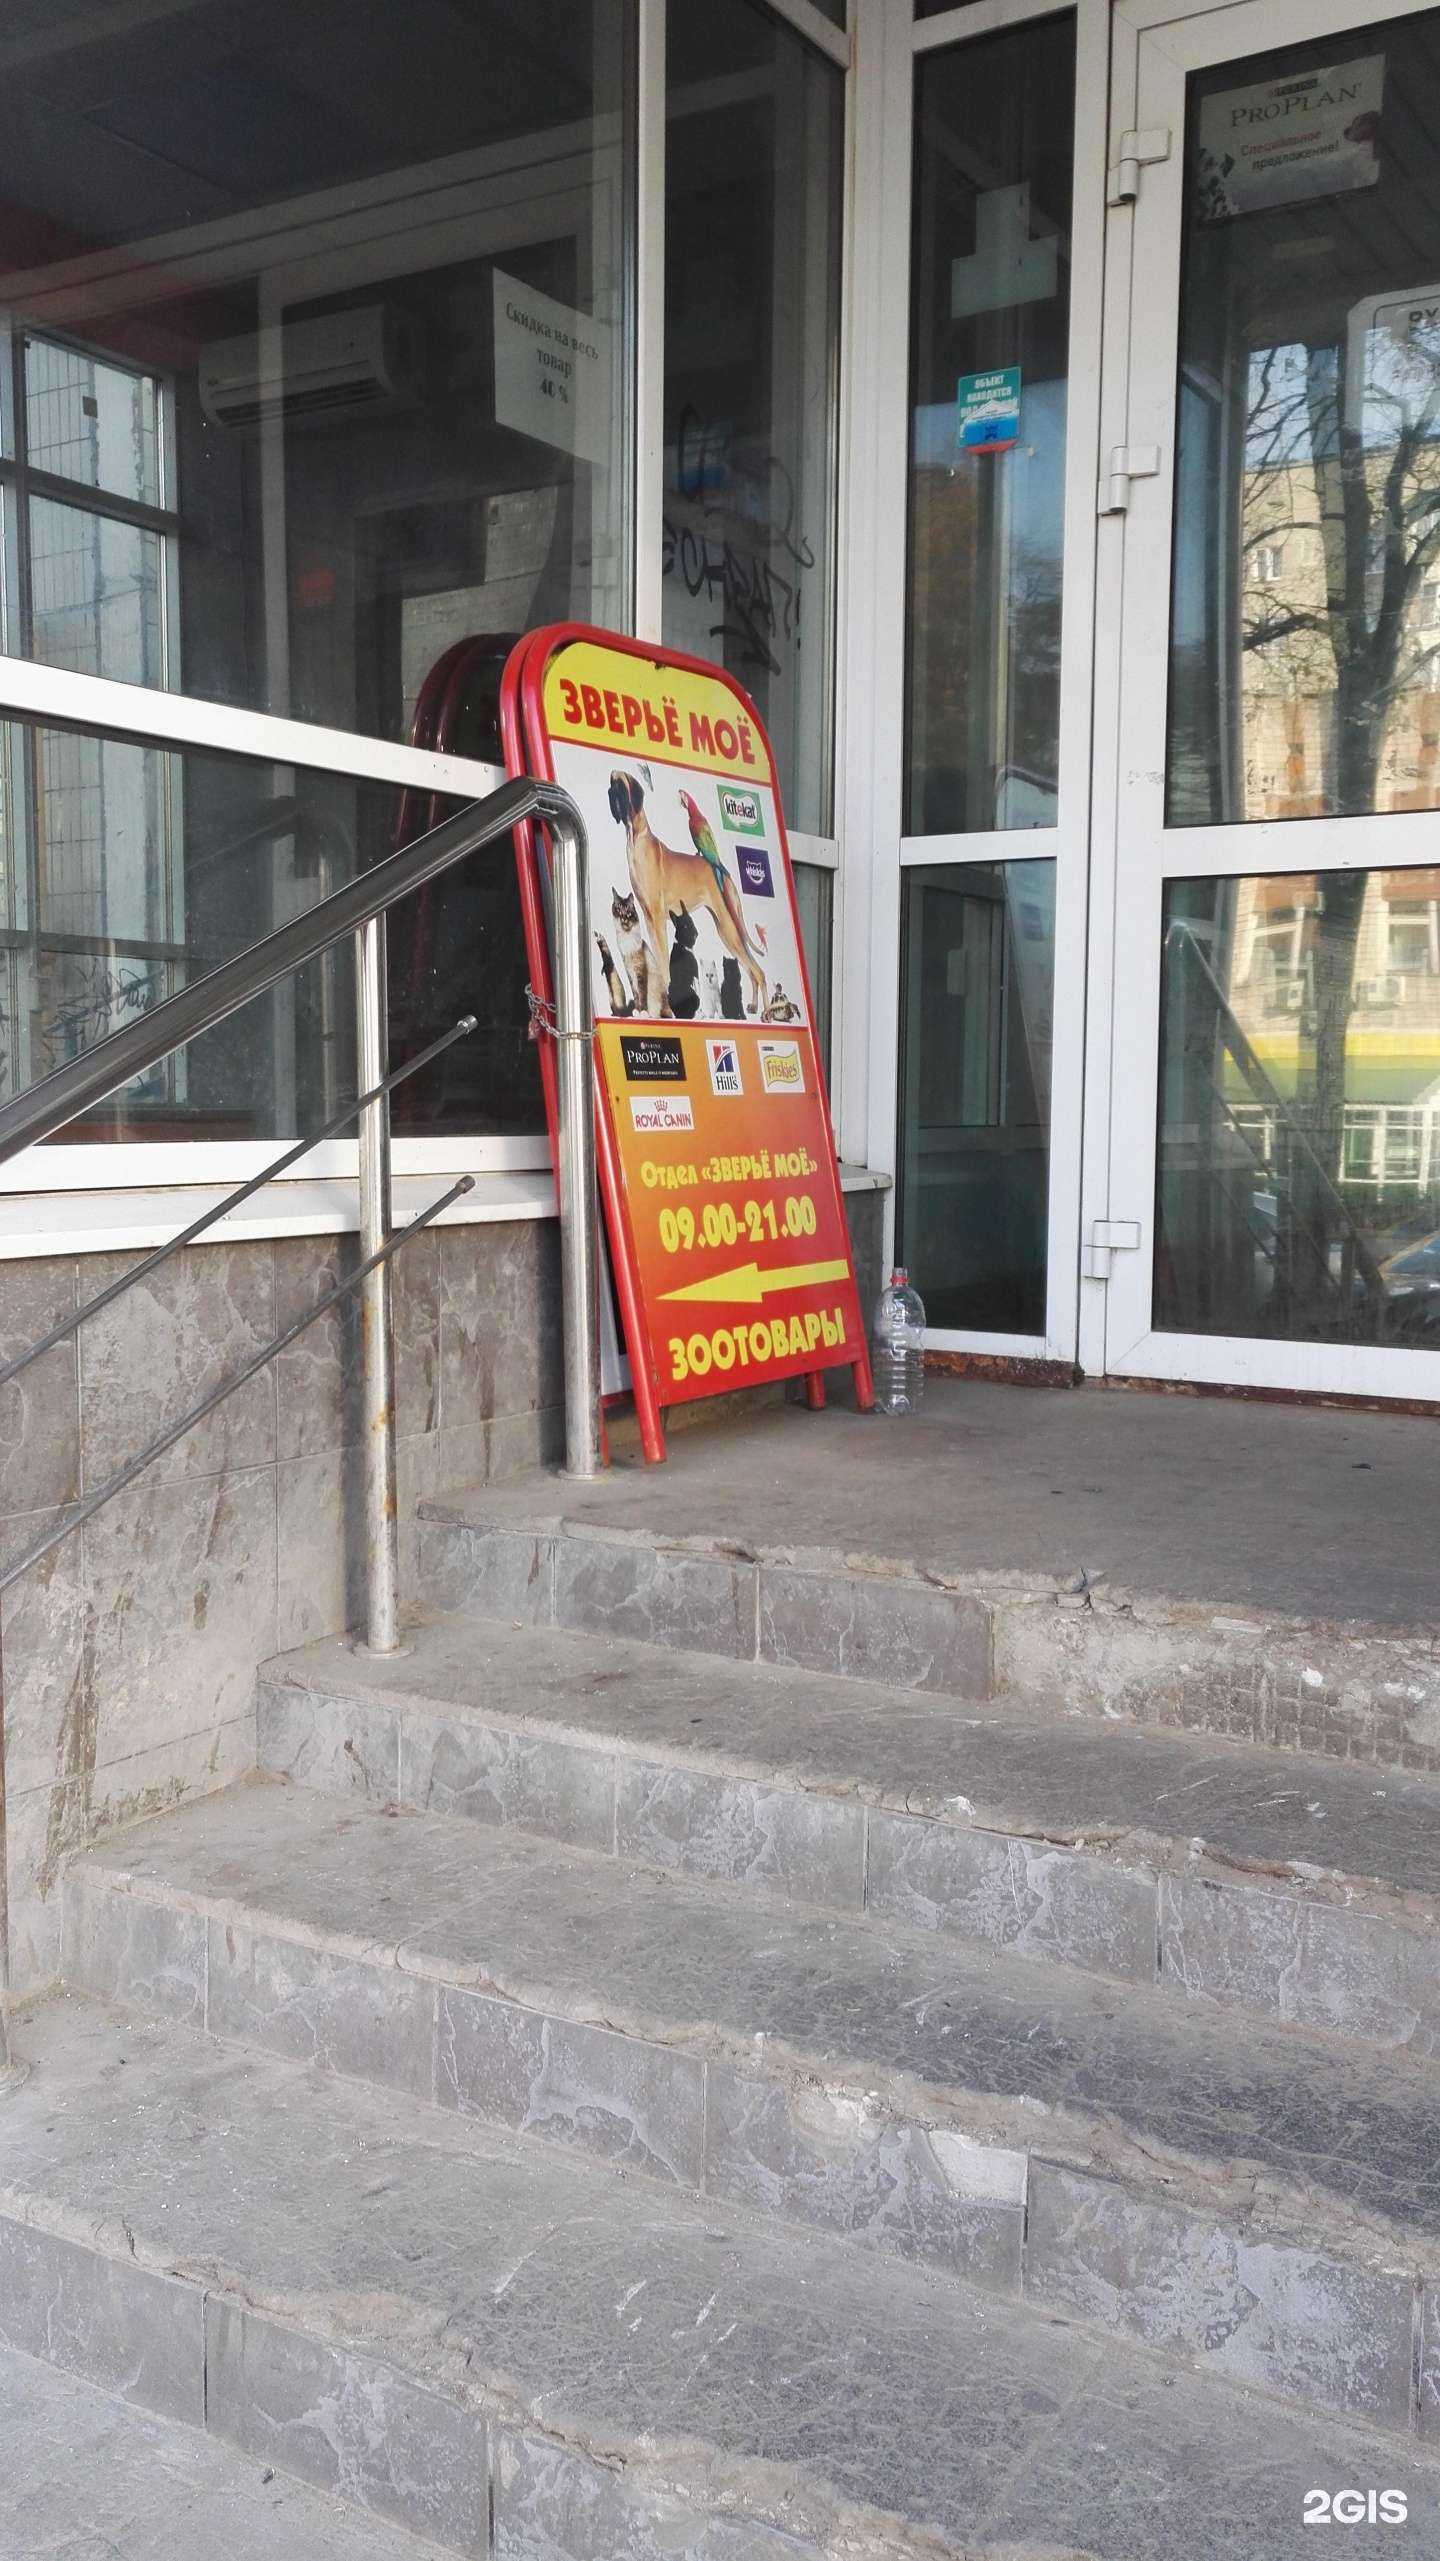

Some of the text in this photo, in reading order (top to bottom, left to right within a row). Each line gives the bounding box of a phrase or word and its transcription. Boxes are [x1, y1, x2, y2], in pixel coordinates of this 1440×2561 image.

[506, 302, 599, 360] Скидка на весь
[537, 349, 572, 378] товар
[559, 678, 757, 765] ЗВЕРЬЁ МОЁ
[725, 797, 757, 820] kitekat
[635, 1112, 692, 1129] ROYAL CANIN
[640, 1160, 699, 1190] Отдел
[658, 1195, 817, 1254] 09.00-21.00
[668, 1306, 847, 1381] ЗООТОВАРЫ
